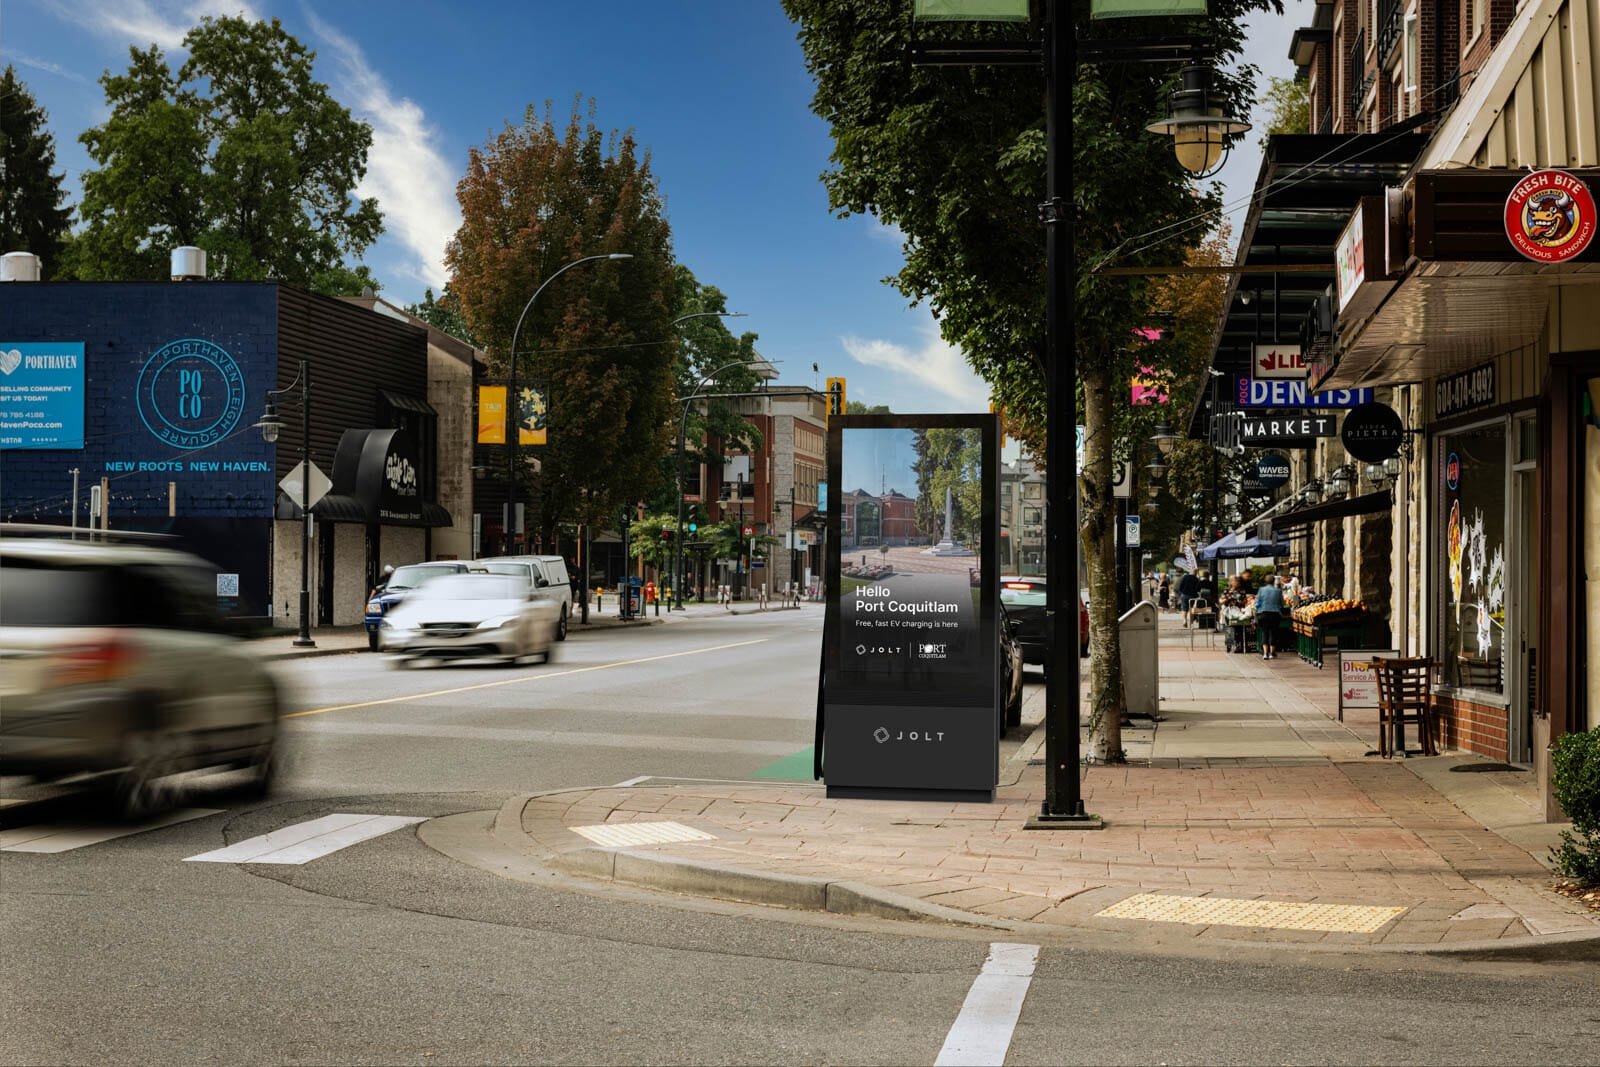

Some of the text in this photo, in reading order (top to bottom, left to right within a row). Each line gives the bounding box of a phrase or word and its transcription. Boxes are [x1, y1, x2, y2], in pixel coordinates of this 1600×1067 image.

[1512, 174, 1583, 203] FRESH BITE
[1514, 221, 1591, 259] DELICIOUS SANDWICH
[25, 355, 77, 369] PORTHAVEN
[160, 343, 240, 445] PORTHAVEN LEIGH SQUARE
[1243, 419, 1328, 436] MARKET
[1347, 429, 1398, 438] PIETRA
[105, 461, 271, 472] NEW ROOTS NEW HAVEN.
[1258, 466, 1289, 474] WAVES
[855, 585, 891, 597] Hello
[855, 600, 959, 616] Port Coquitlam
[855, 619, 874, 628] Free,
[875, 619, 889, 627] fast
[901, 620, 933, 630] charging
[934, 620, 941, 628] is
[942, 620, 959, 628] here
[870, 646, 902, 654] JOLT
[1343, 673, 1367, 681] Service
[896, 731, 945, 741] JOLT
